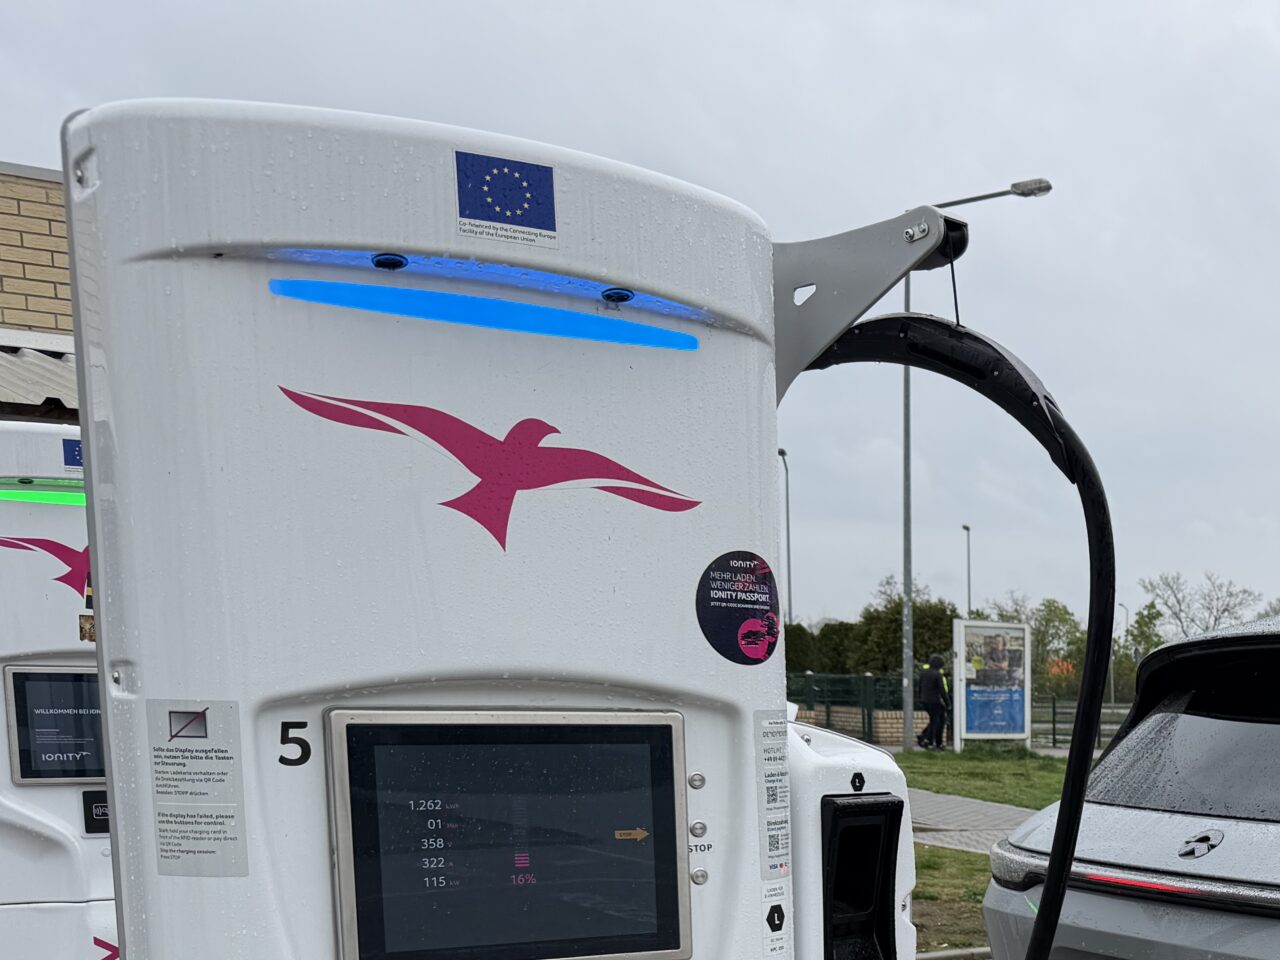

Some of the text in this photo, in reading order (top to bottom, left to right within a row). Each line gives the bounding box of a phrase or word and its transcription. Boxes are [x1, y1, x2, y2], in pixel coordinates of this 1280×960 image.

[459, 227, 478, 236] Facility
[495, 231, 520, 241] European
[520, 234, 536, 243] Union
[509, 227, 538, 238] Connecting
[539, 231, 557, 240] Europe
[730, 560, 756, 568] IONITY
[710, 571, 731, 580] MEHR
[710, 580, 744, 591] WENIGER
[710, 590, 737, 600] IONITY
[279, 721, 311, 766] 5
[42, 753, 82, 761] IONITY
[408, 799, 442, 811] 1.262
[427, 819, 442, 829] 01
[421, 838, 445, 849] 358
[688, 844, 713, 853] STOP
[421, 857, 445, 869] 322
[423, 876, 446, 888] 115
[510, 873, 537, 885] 16%
